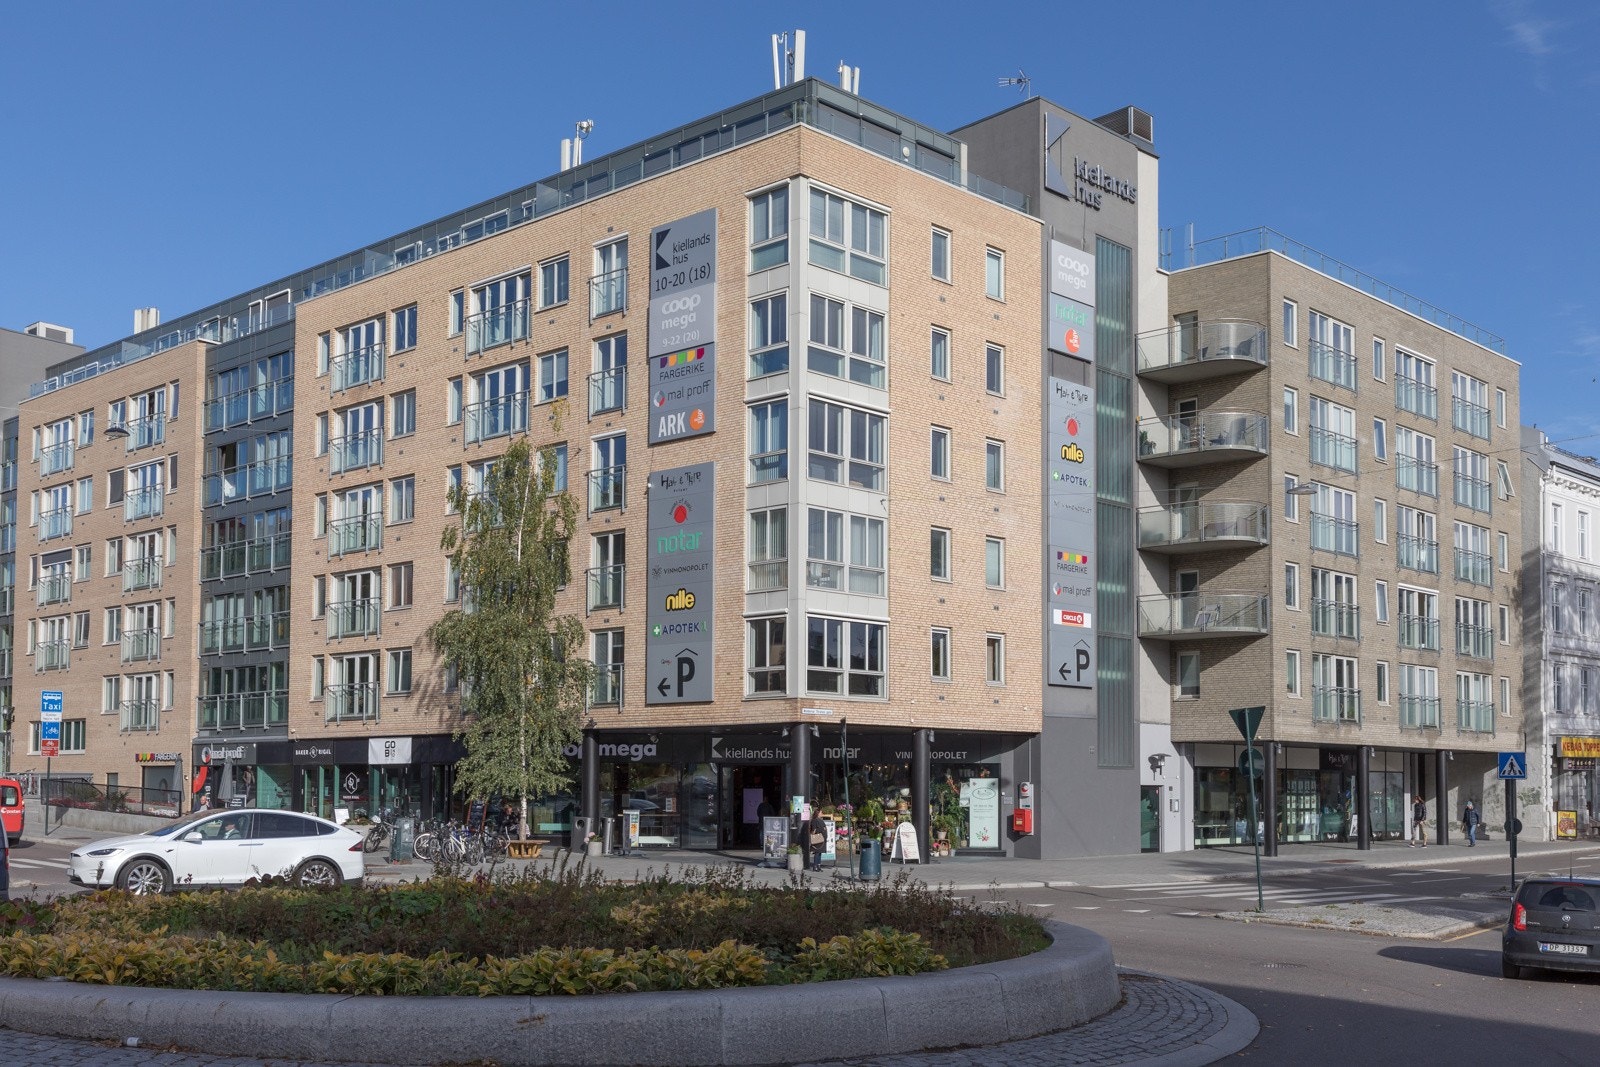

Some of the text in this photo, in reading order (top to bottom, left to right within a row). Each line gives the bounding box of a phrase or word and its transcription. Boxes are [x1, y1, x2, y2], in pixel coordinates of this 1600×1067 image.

[1074, 155, 1138, 203] kiellands
[1075, 184, 1102, 212] hus
[672, 232, 711, 254] kiellands
[672, 253, 689, 266] hus
[1057, 253, 1090, 277] coop
[655, 262, 711, 292] 10-20 (18)
[1058, 270, 1087, 290] mega
[661, 293, 701, 315] coop
[661, 311, 697, 330] mega
[1055, 303, 1088, 327] notar
[662, 329, 700, 348] 9-22 (20)
[659, 363, 705, 380] FARGERIKE
[667, 379, 711, 401] mal proff
[658, 411, 686, 438] ARK
[1060, 442, 1085, 464] nille
[1060, 473, 1087, 487] APOTEK
[657, 528, 703, 555] notar
[664, 563, 708, 576] VINMONOPOLET
[1057, 562, 1088, 576] FARGERIKE
[666, 587, 696, 612] nille
[1062, 584, 1092, 598] mal proff
[662, 622, 700, 636] APOTEK
[1076, 648, 1090, 682] P
[677, 656, 696, 698] P
[43, 701, 61, 711] Taxi
[211, 747, 225, 759] mal
[384, 740, 396, 749] GO
[598, 743, 657, 762] mega
[725, 747, 773, 759] kiellands
[823, 747, 861, 759] noar
[1562, 741, 1582, 752] KEBAB
[895, 750, 967, 760] VINOPOLET
[1549, 943, 1585, 953] DP 31357
